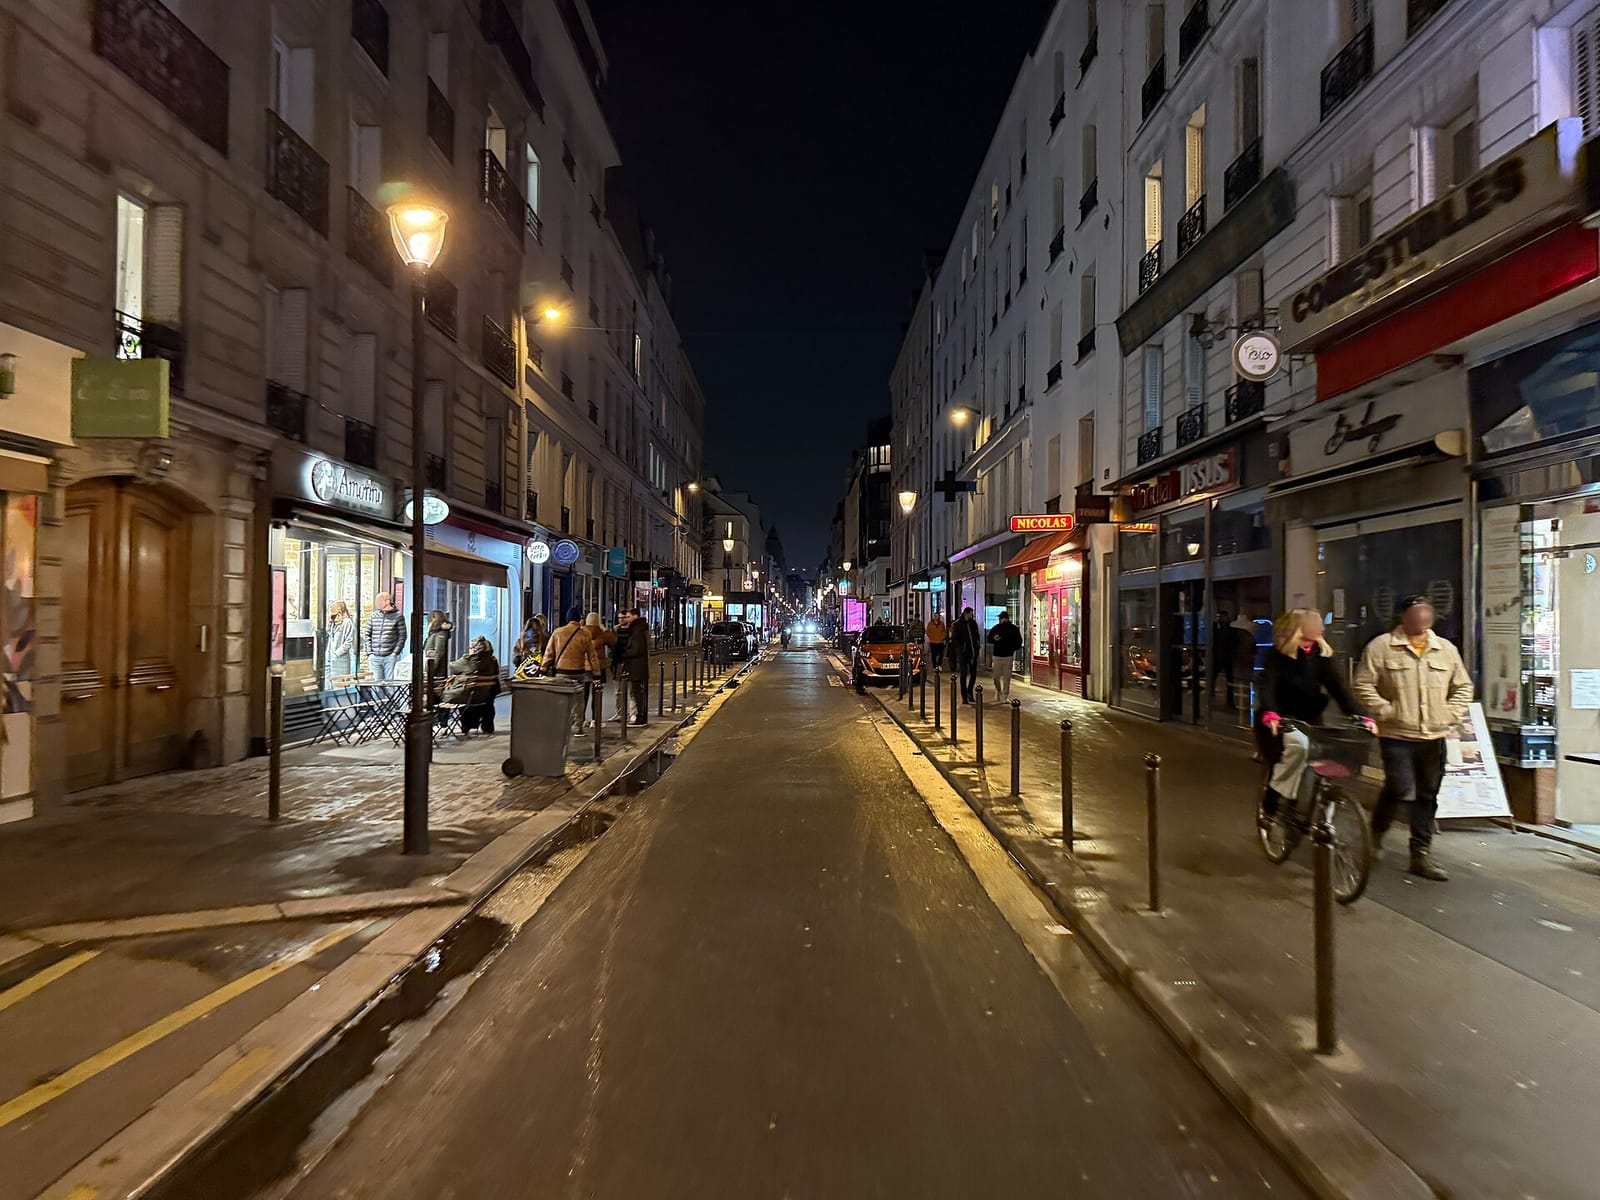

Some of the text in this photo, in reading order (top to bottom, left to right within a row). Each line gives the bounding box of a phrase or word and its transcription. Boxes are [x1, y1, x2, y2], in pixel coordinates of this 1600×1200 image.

[336, 468, 384, 505] Amorino
[1178, 454, 1230, 497] TISSUS
[1017, 517, 1067, 529] NICOLAS
